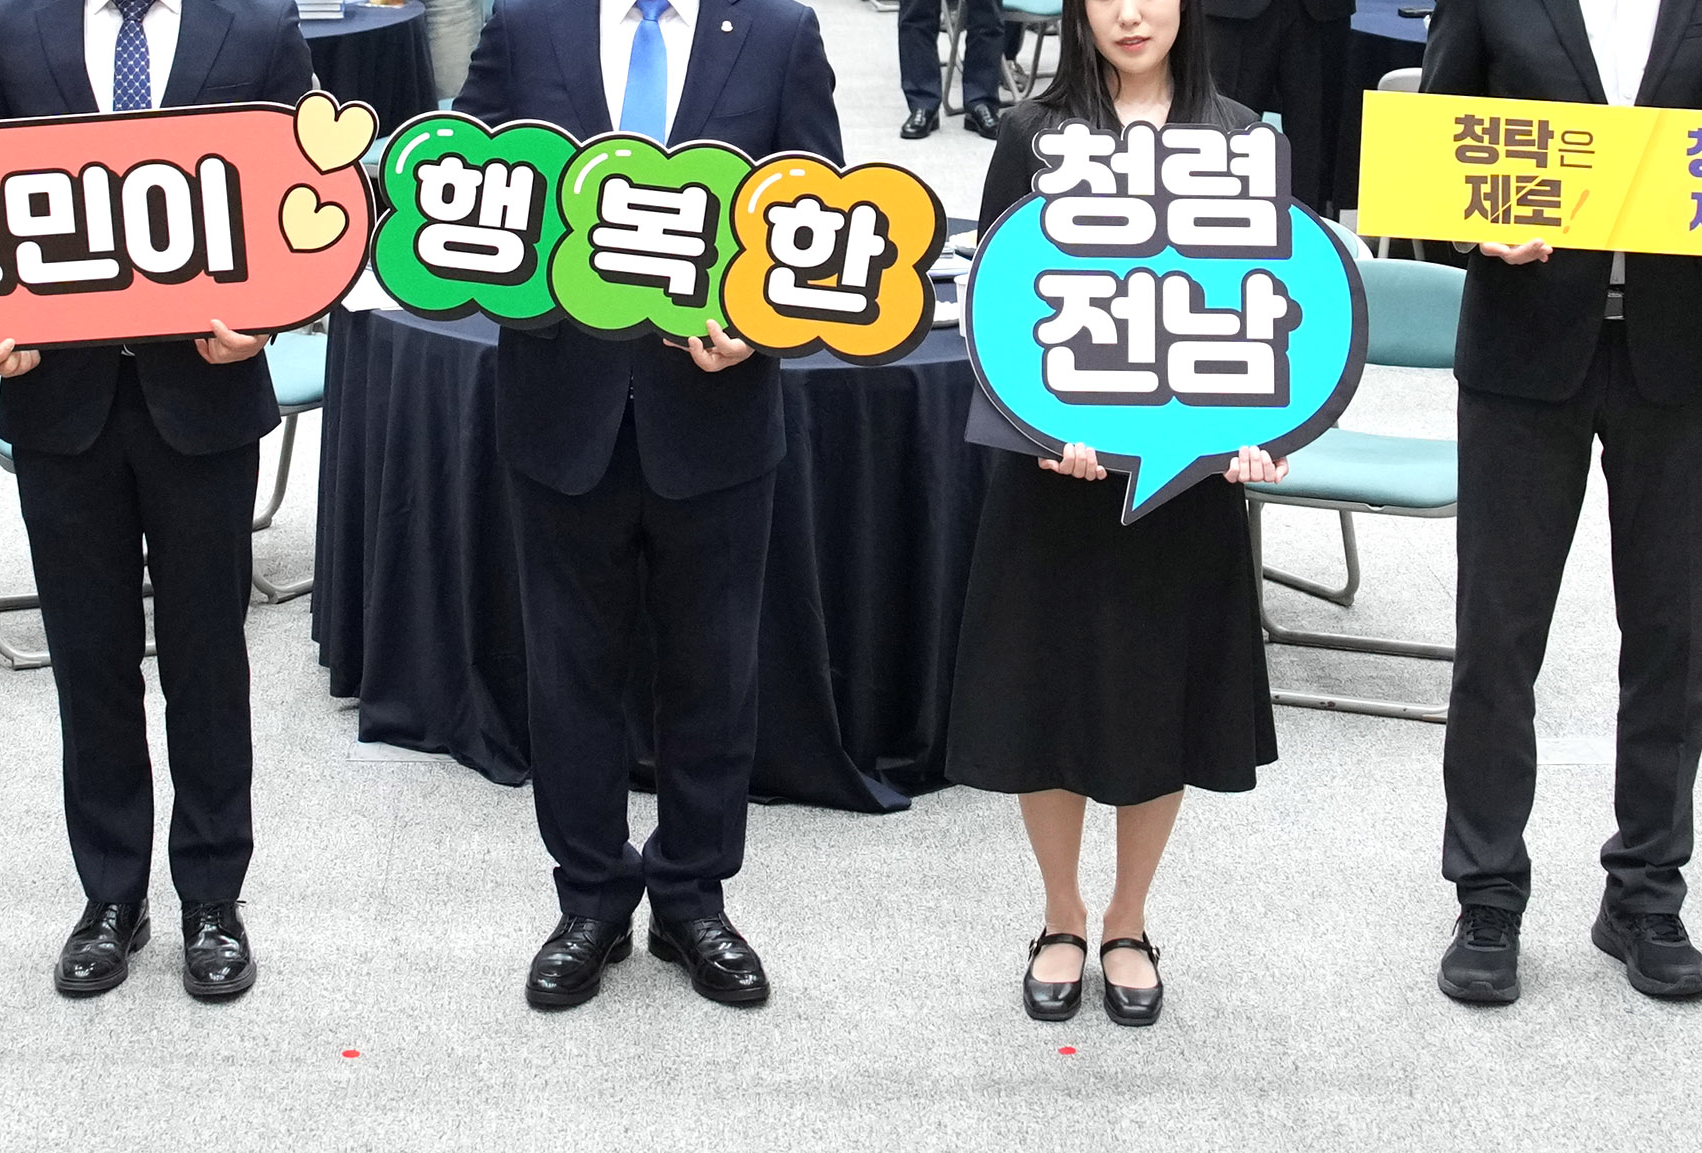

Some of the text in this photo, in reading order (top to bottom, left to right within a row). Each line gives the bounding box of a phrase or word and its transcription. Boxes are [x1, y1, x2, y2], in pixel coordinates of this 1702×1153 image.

[1038, 124, 1281, 248] 청렴
[1453, 113, 1596, 169] 청탁은
[414, 153, 887, 314] 행복한
[1463, 174, 1591, 234] 제로!
[1038, 272, 1289, 397] 전남
